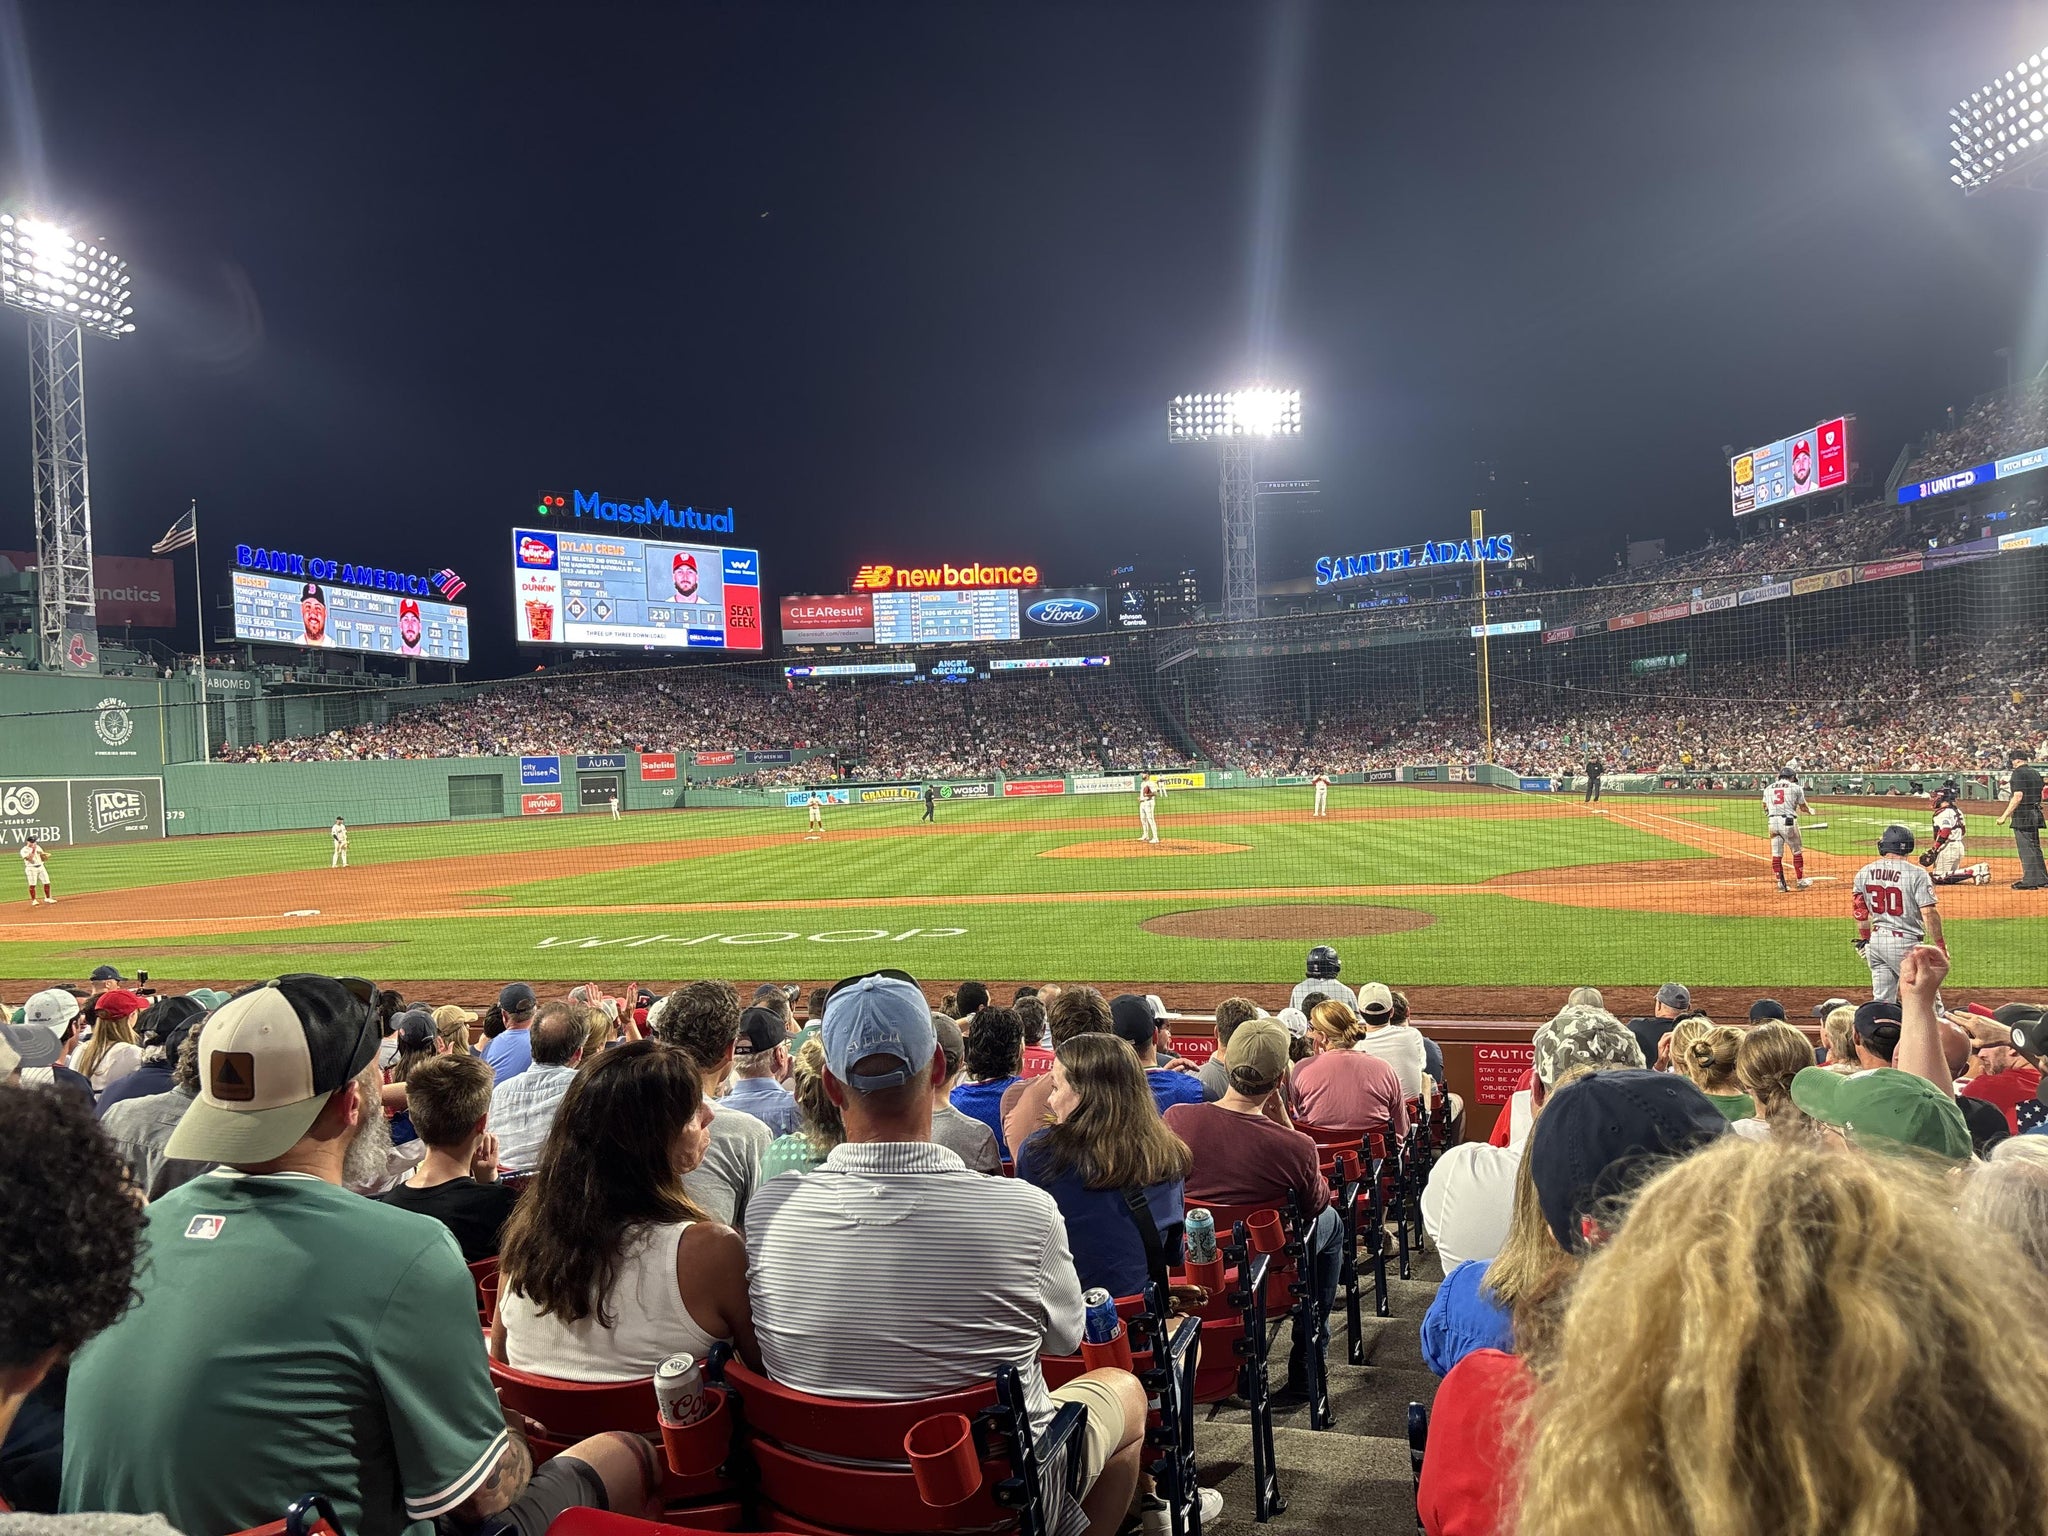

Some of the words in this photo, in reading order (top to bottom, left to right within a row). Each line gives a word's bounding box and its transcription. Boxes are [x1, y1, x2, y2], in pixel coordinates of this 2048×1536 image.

[2003, 461, 2021, 472] PITCH
[2022, 454, 2043, 467] BREAK
[1931, 470, 1976, 494] UNITED
[573, 489, 735, 534] MassMutual
[560, 541, 593, 553] DYLAN
[595, 544, 626, 556] CREWS
[1315, 548, 1416, 586] SAMUEL
[1419, 534, 1514, 567] ADAMS
[236, 544, 305, 575] BANK
[309, 557, 338, 580] OF
[342, 563, 430, 596] AMERICA
[649, 610, 670, 620] .230
[730, 605, 754, 617] SEAT
[790, 606, 863, 618] CLEAResult
[1041, 602, 1085, 621] Ford
[335, 620, 352, 630] BALLS
[355, 623, 375, 632] STRIKES
[379, 625, 392, 634] OUTS
[730, 617, 756, 628] GEEK
[362, 633, 369, 647] 2
[383, 636, 390, 649] 2
[931, 667, 975, 675] ORCHARD
[207, 678, 251, 690] ABIOMED
[711, 754, 734, 763] TICKET
[642, 762, 675, 770] Safelite
[523, 769, 548, 777] cruises
[1182, 778, 1194, 786] TEA
[662, 788, 674, 796] 420
[862, 789, 899, 801] GRANITE
[900, 788, 920, 799] CITY
[952, 784, 988, 794] wasabi
[100, 792, 140, 811] ACE
[528, 800, 556, 808] IRVING
[1773, 790, 1785, 805] 3
[101, 807, 141, 823] TICKET
[166, 811, 185, 820] 379
[12, 826, 61, 844] WEBB
[1870, 868, 1901, 883] YOUNG
[1865, 884, 1904, 917] 30
[532, 928, 969, 950] WHOOP
[1478, 1049, 1535, 1060] CAUTIO
